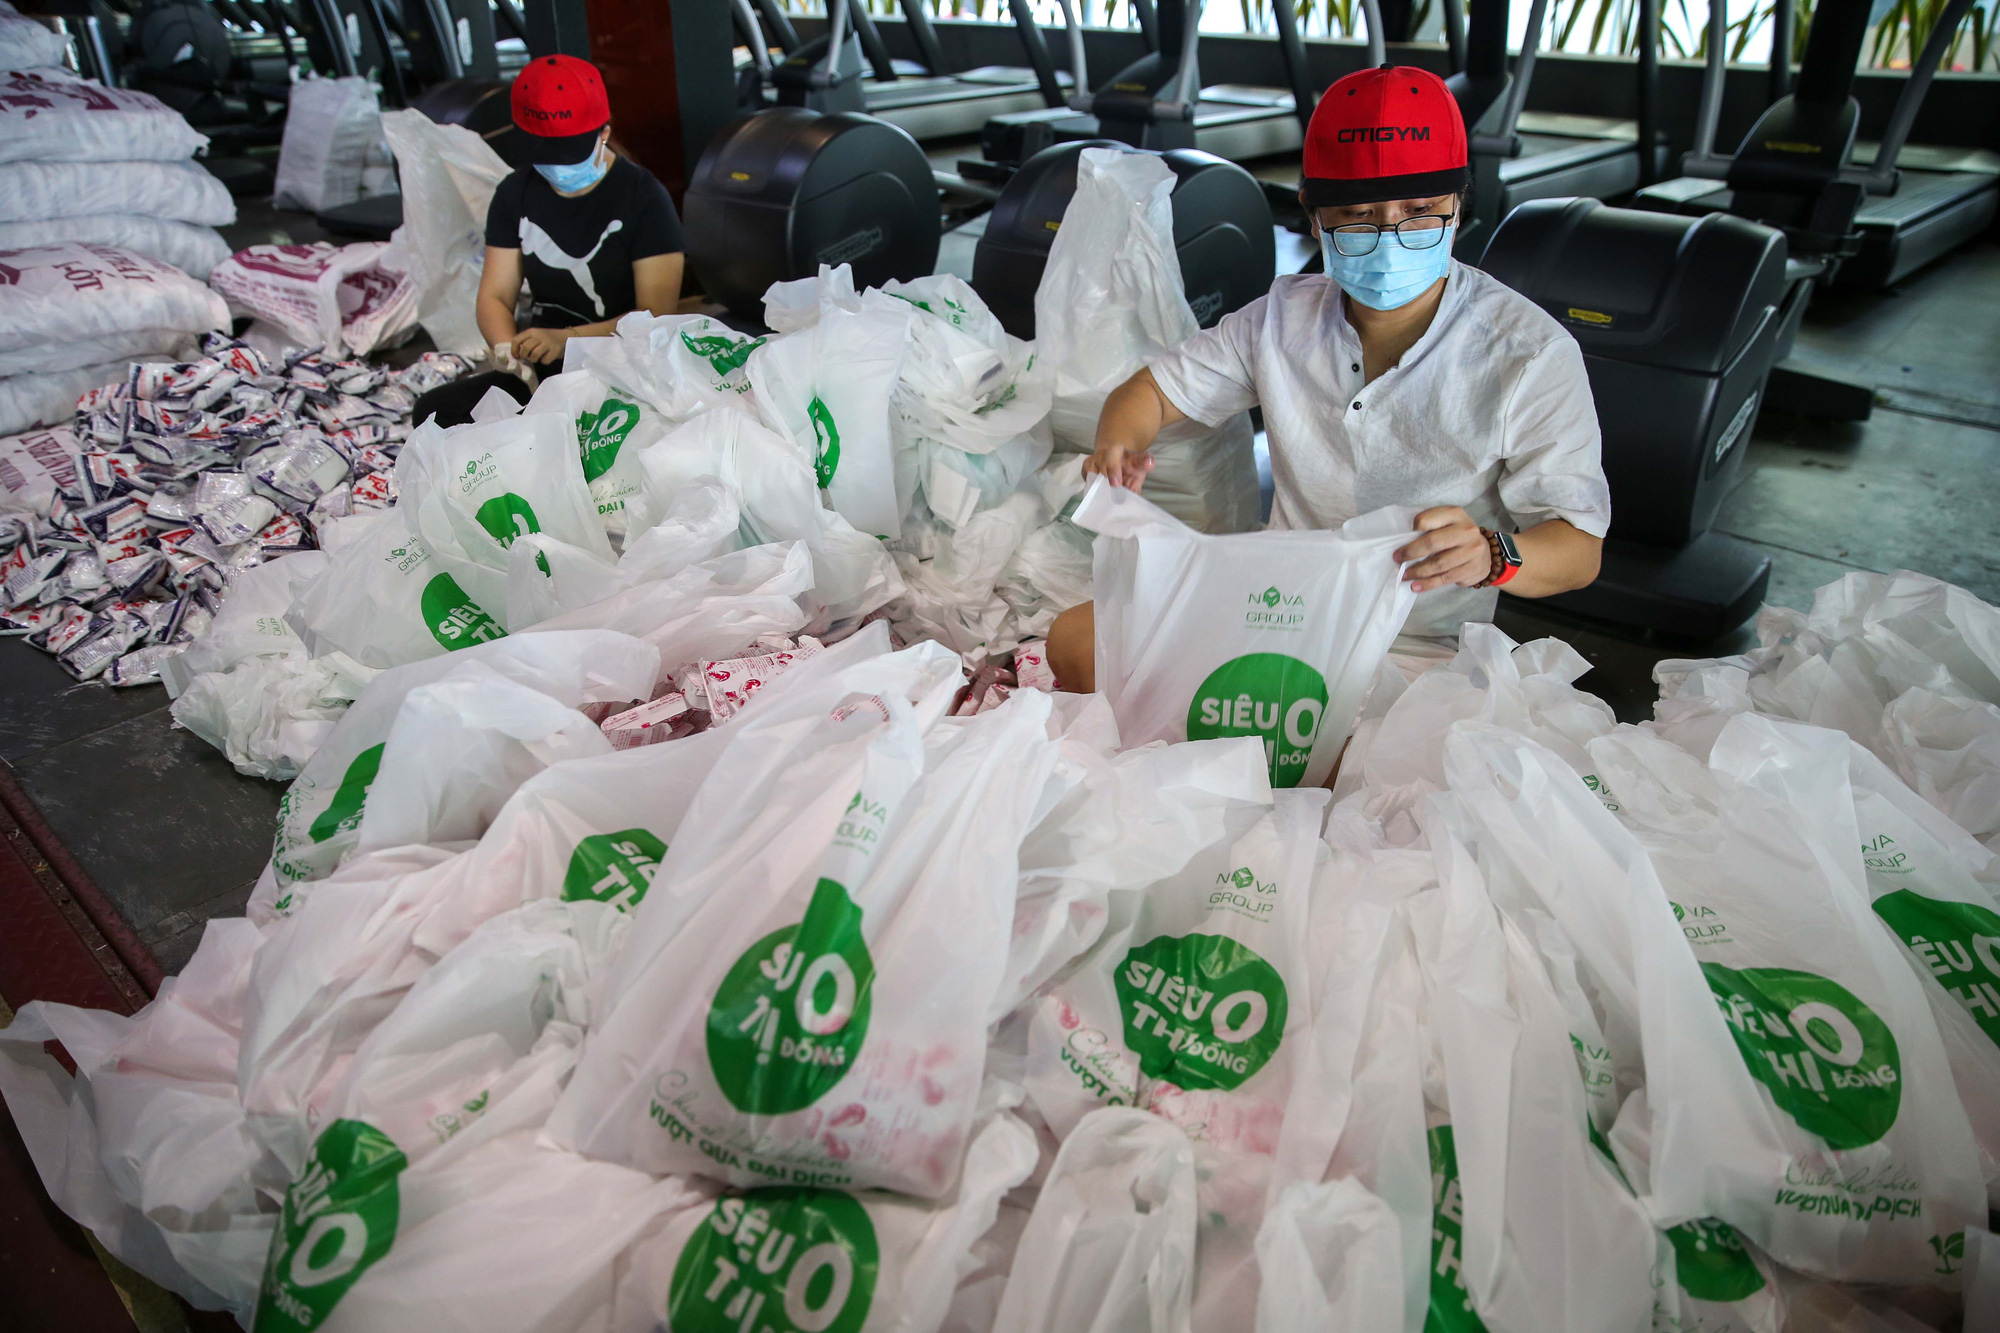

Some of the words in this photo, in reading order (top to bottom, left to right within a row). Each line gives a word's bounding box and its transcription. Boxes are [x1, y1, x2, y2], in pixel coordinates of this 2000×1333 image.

[1337, 126, 1431, 143] CITIGYM
[591, 433, 622, 451] ĐỒNG
[459, 452, 493, 483] NOVA
[462, 464, 497, 493] GROUP
[1247, 585, 1305, 609] NOVA
[1245, 610, 1305, 625] GROUP
[1199, 693, 1280, 731] SIÊU
[1279, 749, 1311, 767] ĐỒN
[591, 862, 638, 916] TH
[1215, 866, 1277, 895] NOVA
[1209, 892, 1274, 914] GROUP
[1910, 934, 1974, 978] ÊU
[1125, 960, 1215, 1021] SIÊU
[779, 1037, 846, 1067] ĐỒNG
[1186, 1040, 1249, 1075] ĐỒNG
[1830, 1064, 1898, 1090] ĐỒNG
[650, 1099, 695, 1147] VƯỢT
[699, 1138, 741, 1170] QUA
